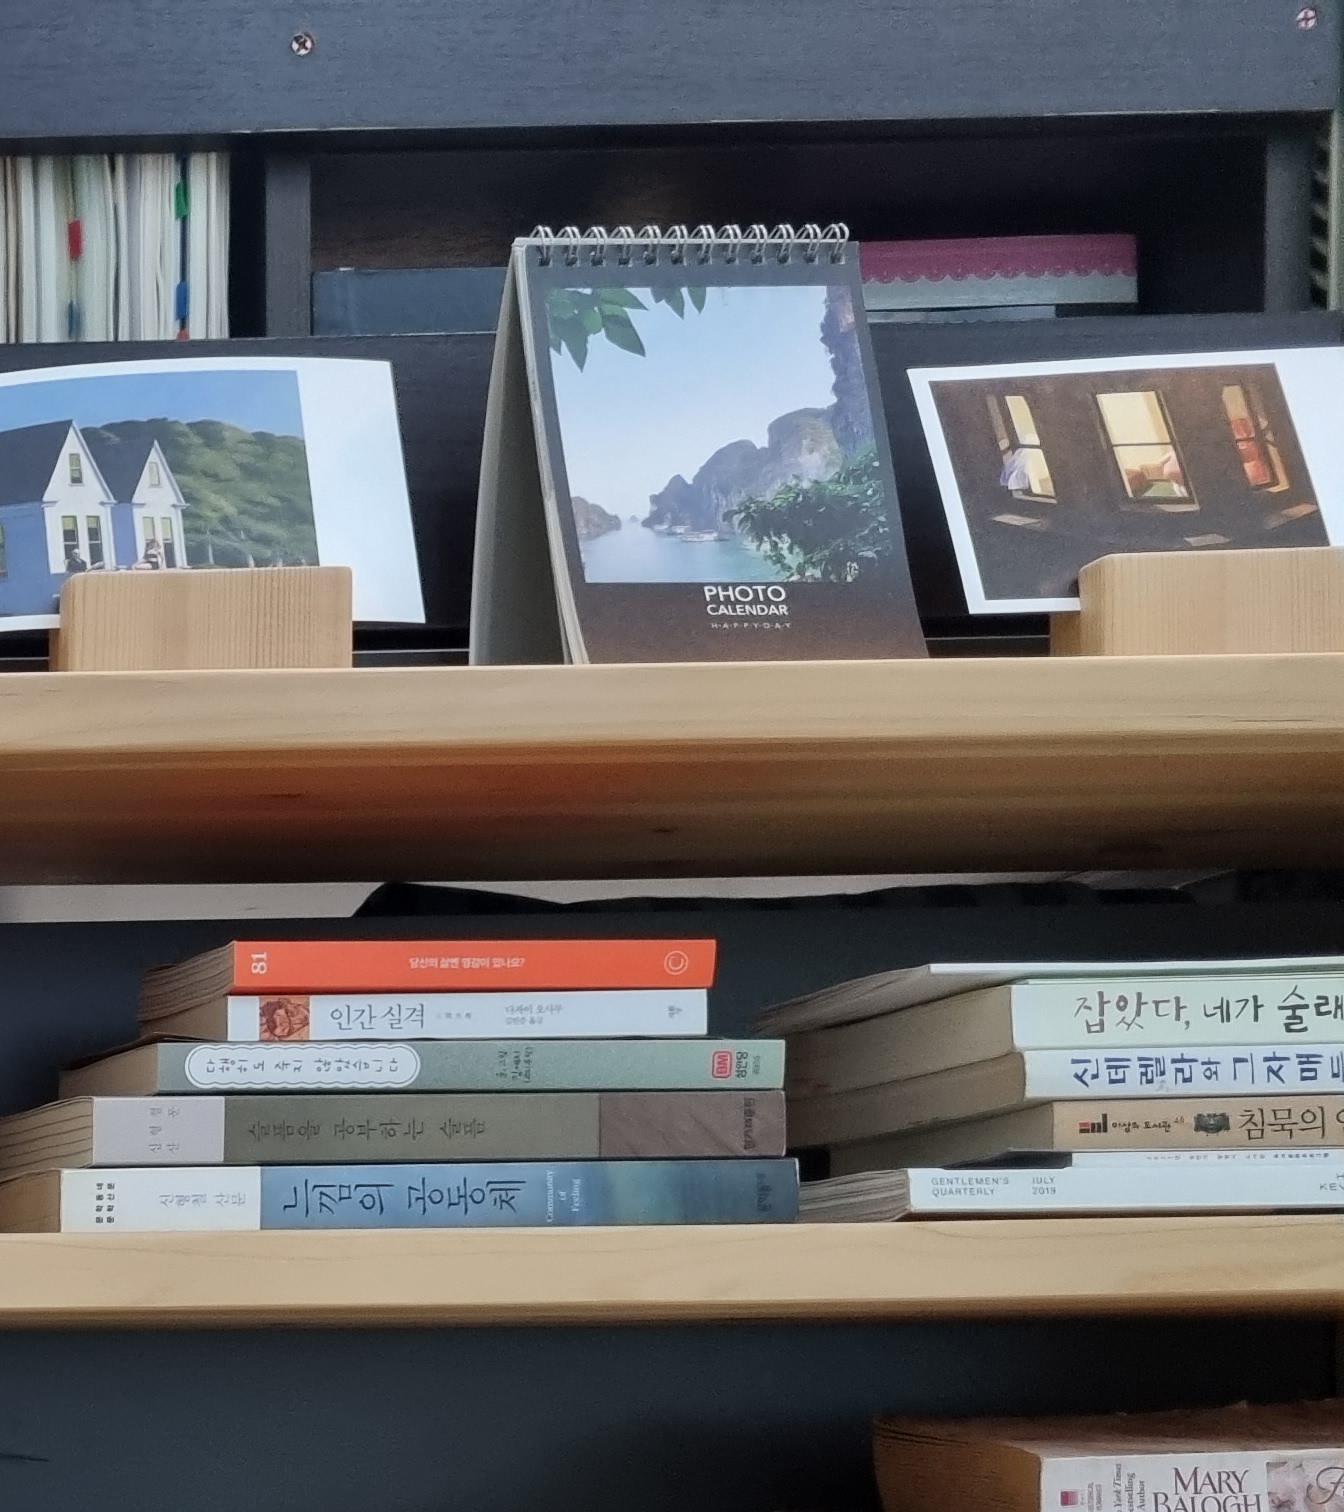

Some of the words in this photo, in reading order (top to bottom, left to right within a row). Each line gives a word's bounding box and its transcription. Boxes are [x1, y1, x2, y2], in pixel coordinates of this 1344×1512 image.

[703, 585, 786, 602] PHOTO
[706, 604, 789, 616] CALENDAR
[330, 1003, 379, 1031] 인간
[382, 1003, 425, 1029] 실격
[1074, 990, 1190, 1034] 잡았다,
[1202, 994, 1265, 1024] 네가
[1070, 1052, 1221, 1088] 신데렐라와
[1111, 1121, 1140, 1133] 이상의
[1238, 1106, 1325, 1141] 침묵의
[931, 1177, 1010, 1187] GENTLEMEN'S
[1032, 1176, 1056, 1185] JULY
[931, 1187, 995, 1197] QUARTERLY
[1032, 1186, 1057, 1195] 2019
[283, 1178, 395, 1218] 느낌의
[408, 1176, 527, 1217] 공동체
[1137, 1479, 1147, 1511] Author
[1172, 1467, 1250, 1496] MARY
